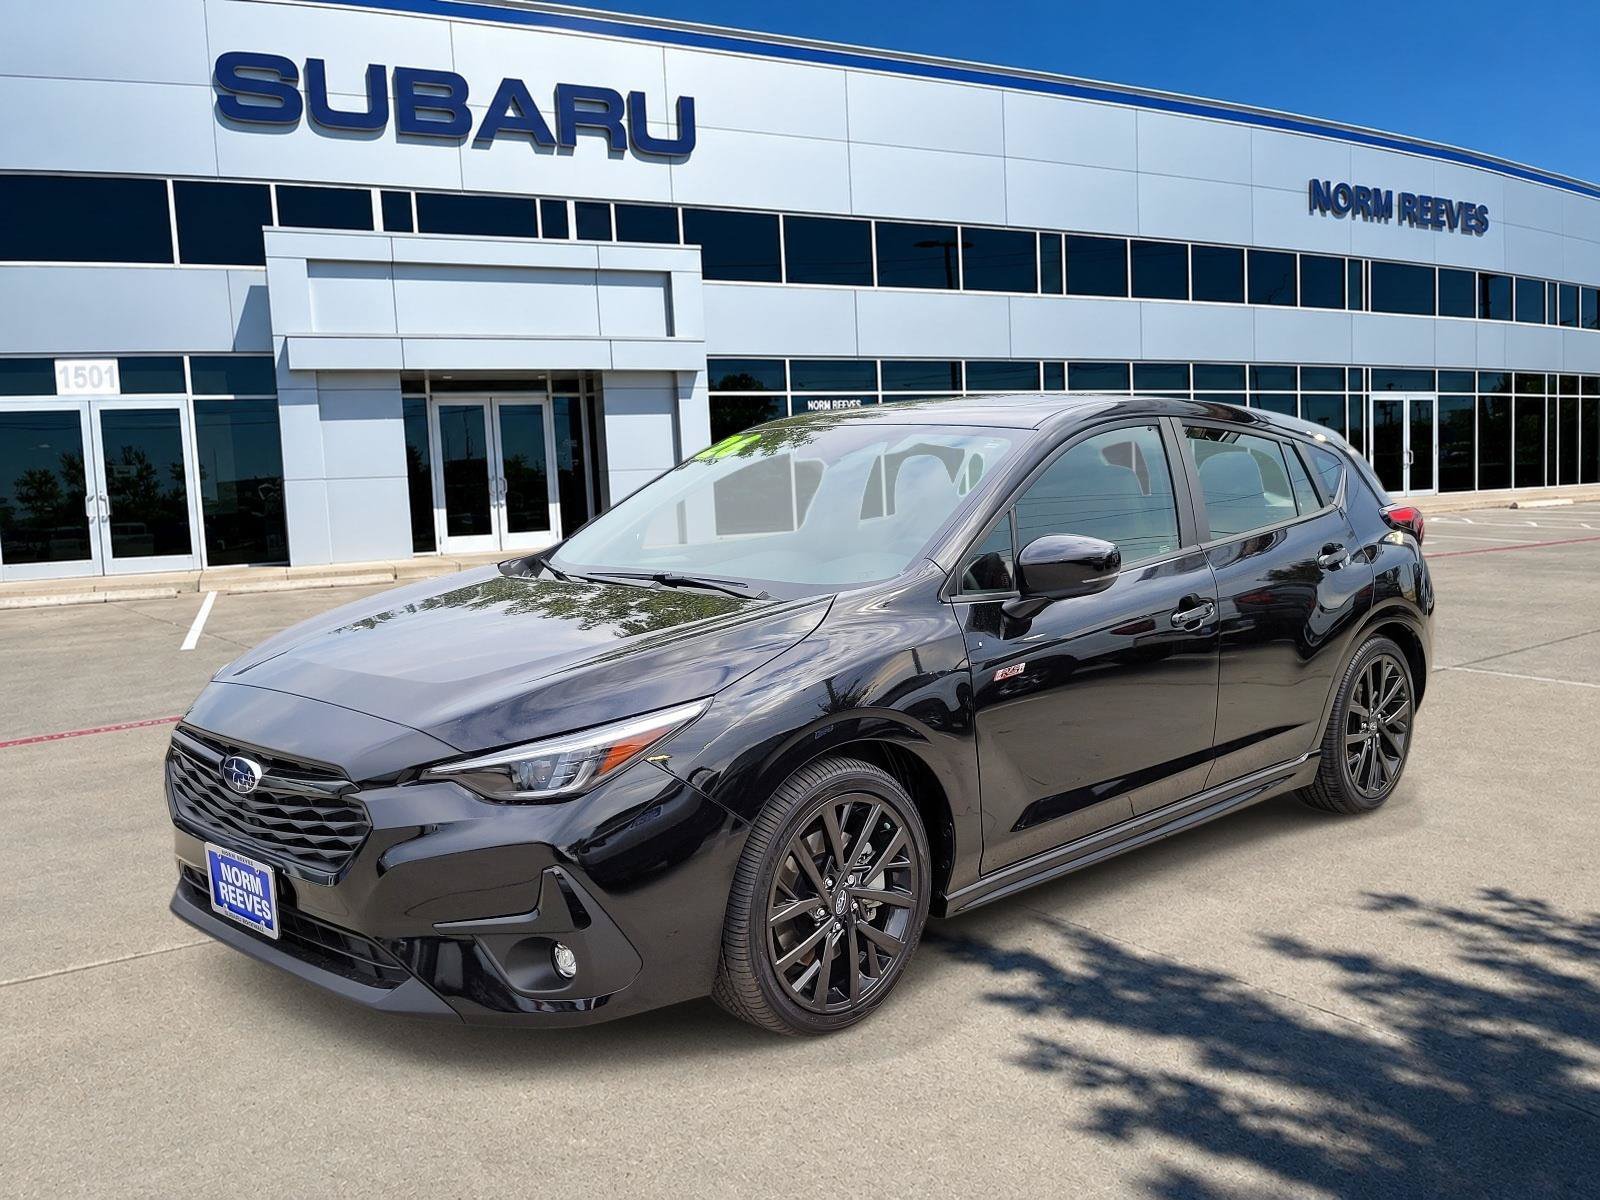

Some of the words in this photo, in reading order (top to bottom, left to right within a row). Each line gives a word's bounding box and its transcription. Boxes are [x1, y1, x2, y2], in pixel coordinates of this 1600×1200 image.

[215, 51, 696, 156] SUBARU
[1309, 178, 1393, 221] NORM
[1398, 191, 1490, 235] REEVES
[59, 364, 115, 389] 1501
[807, 400, 831, 411] NORM
[220, 862, 263, 897] NORM
[218, 881, 272, 920] REEVES
